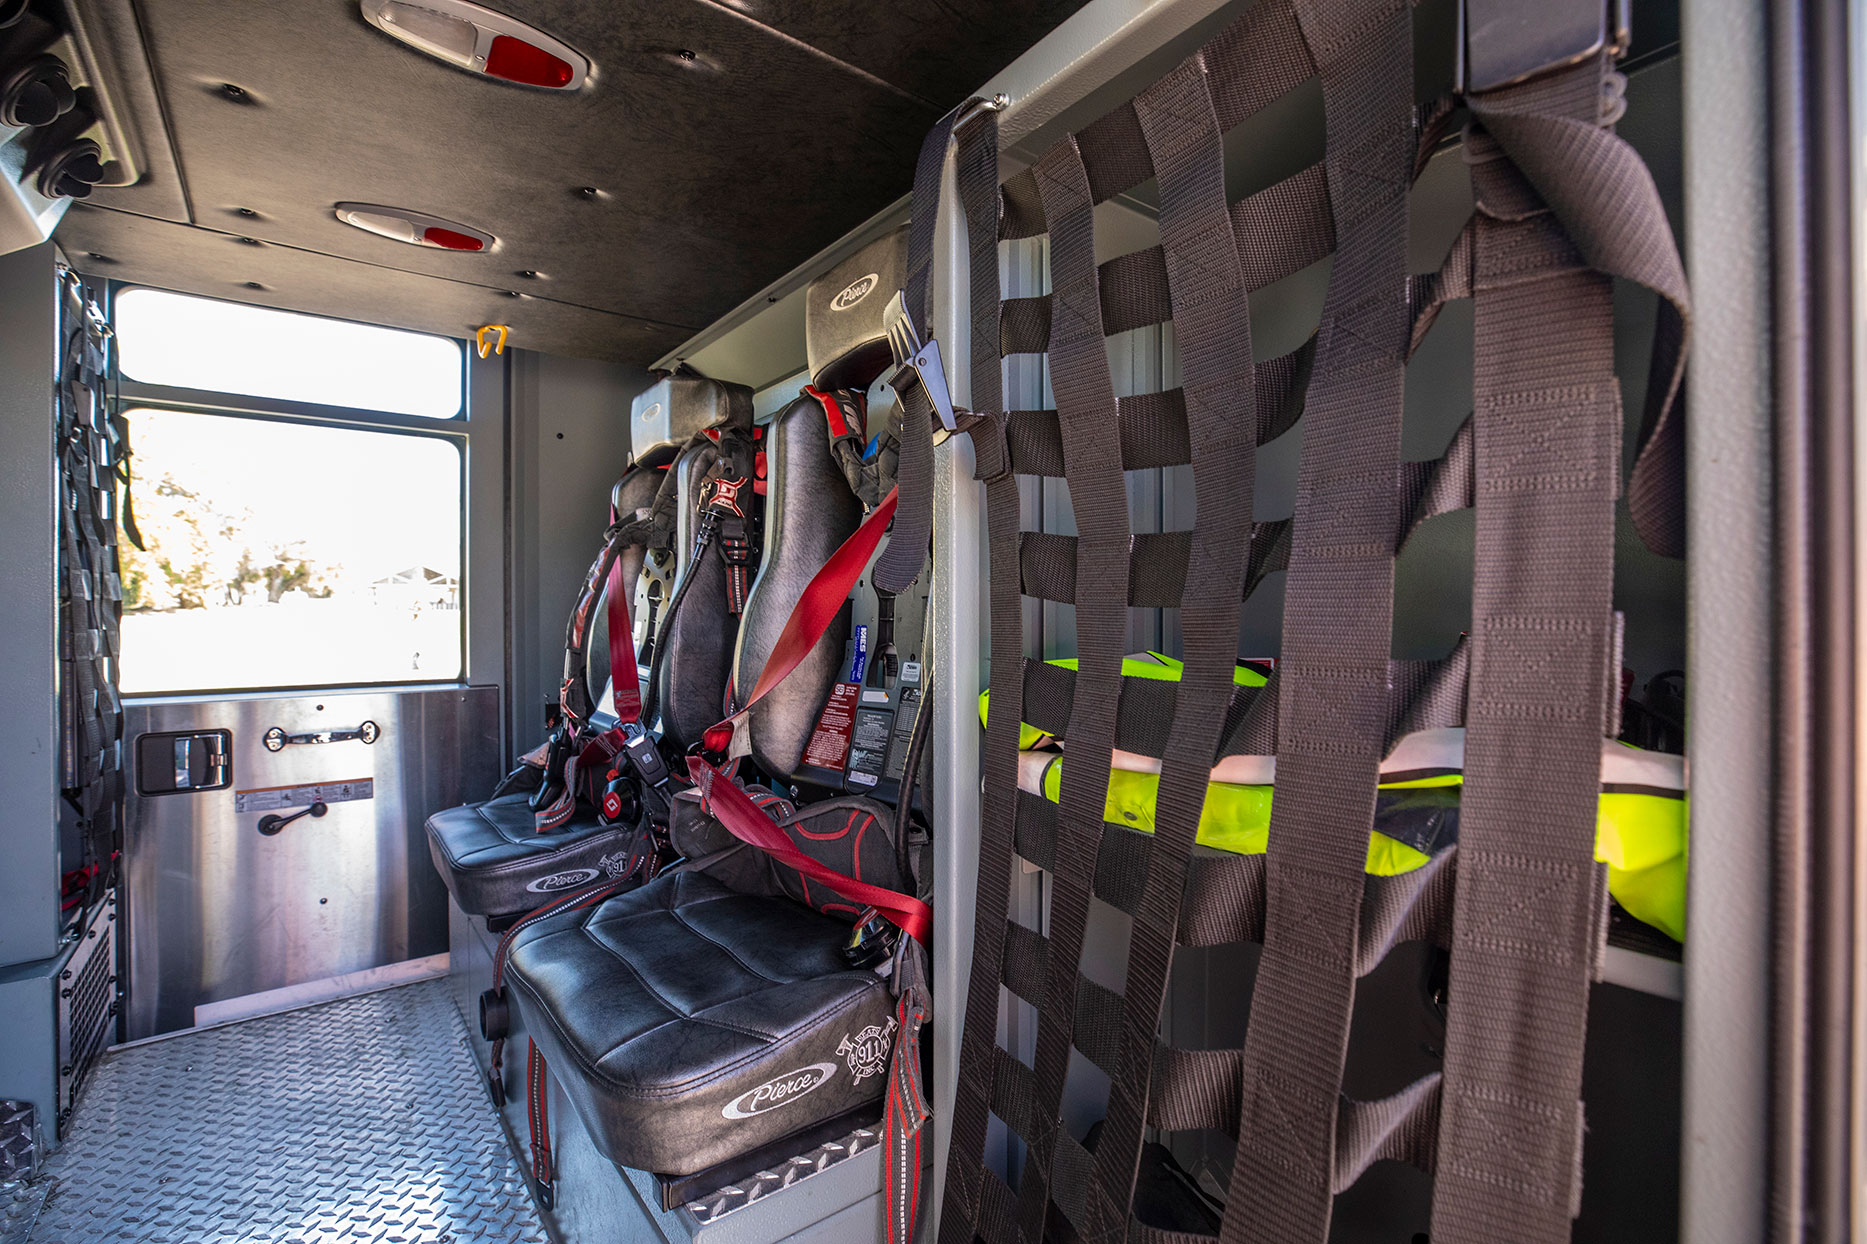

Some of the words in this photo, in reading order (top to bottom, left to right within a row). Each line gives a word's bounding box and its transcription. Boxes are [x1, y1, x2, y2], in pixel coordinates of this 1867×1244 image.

[543, 873, 583, 890] Pierce
[858, 1040, 881, 1064] 911
[750, 1072, 813, 1112] Pierce
